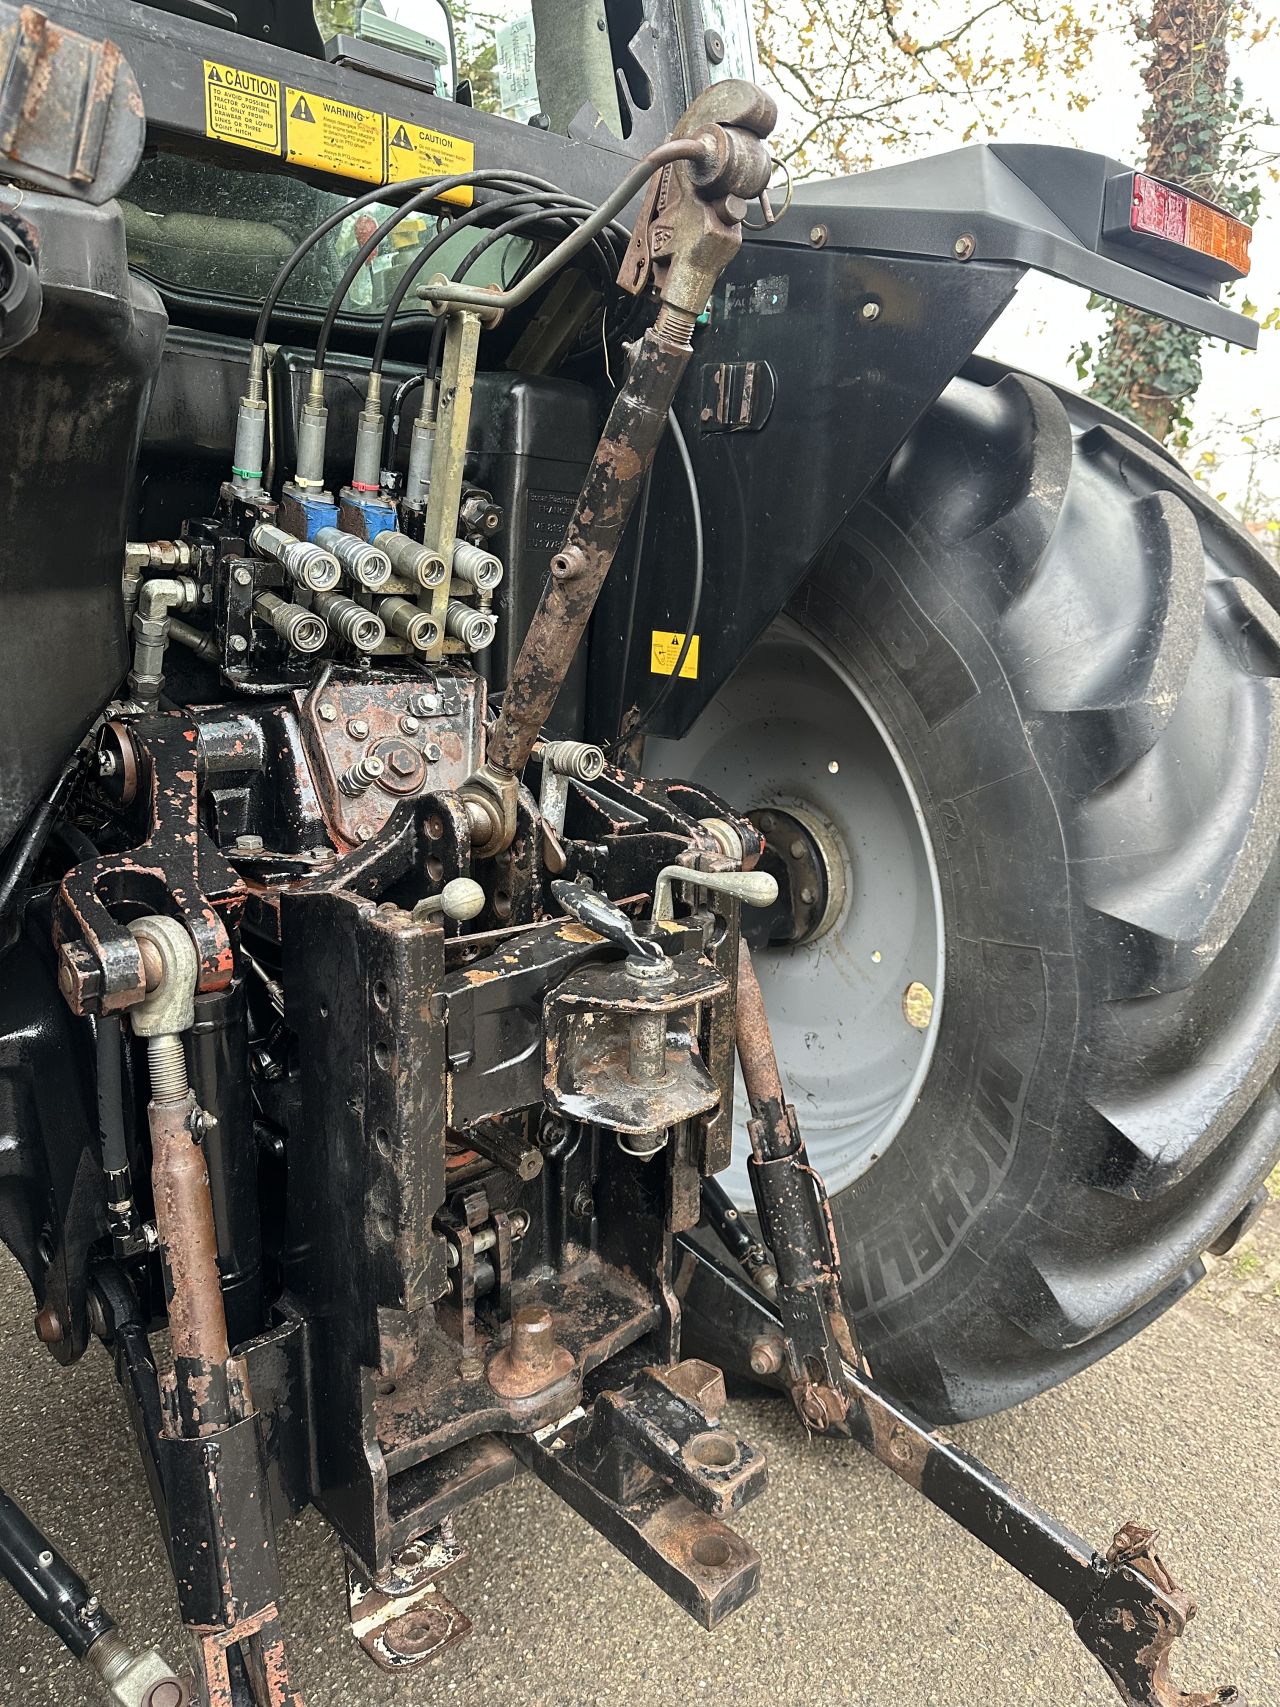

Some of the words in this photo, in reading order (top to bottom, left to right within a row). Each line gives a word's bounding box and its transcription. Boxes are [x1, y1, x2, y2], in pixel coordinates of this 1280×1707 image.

[226, 70, 276, 98] CAUTION
[214, 96, 238, 106] TRACTOR
[225, 92, 242, 101] AVOID
[245, 98, 269, 108] POSSIBLE
[215, 110, 241, 121] DRAWBAR
[256, 121, 273, 129] LOWER
[231, 107, 245, 115] ONLY
[248, 112, 263, 120] FROM
[323, 103, 363, 122] WARNING
[215, 116, 231, 125] LINKS
[245, 124, 261, 132] THREE
[216, 123, 232, 131] POINT
[236, 128, 251, 136] HITCH
[419, 131, 452, 149] CAUTION
